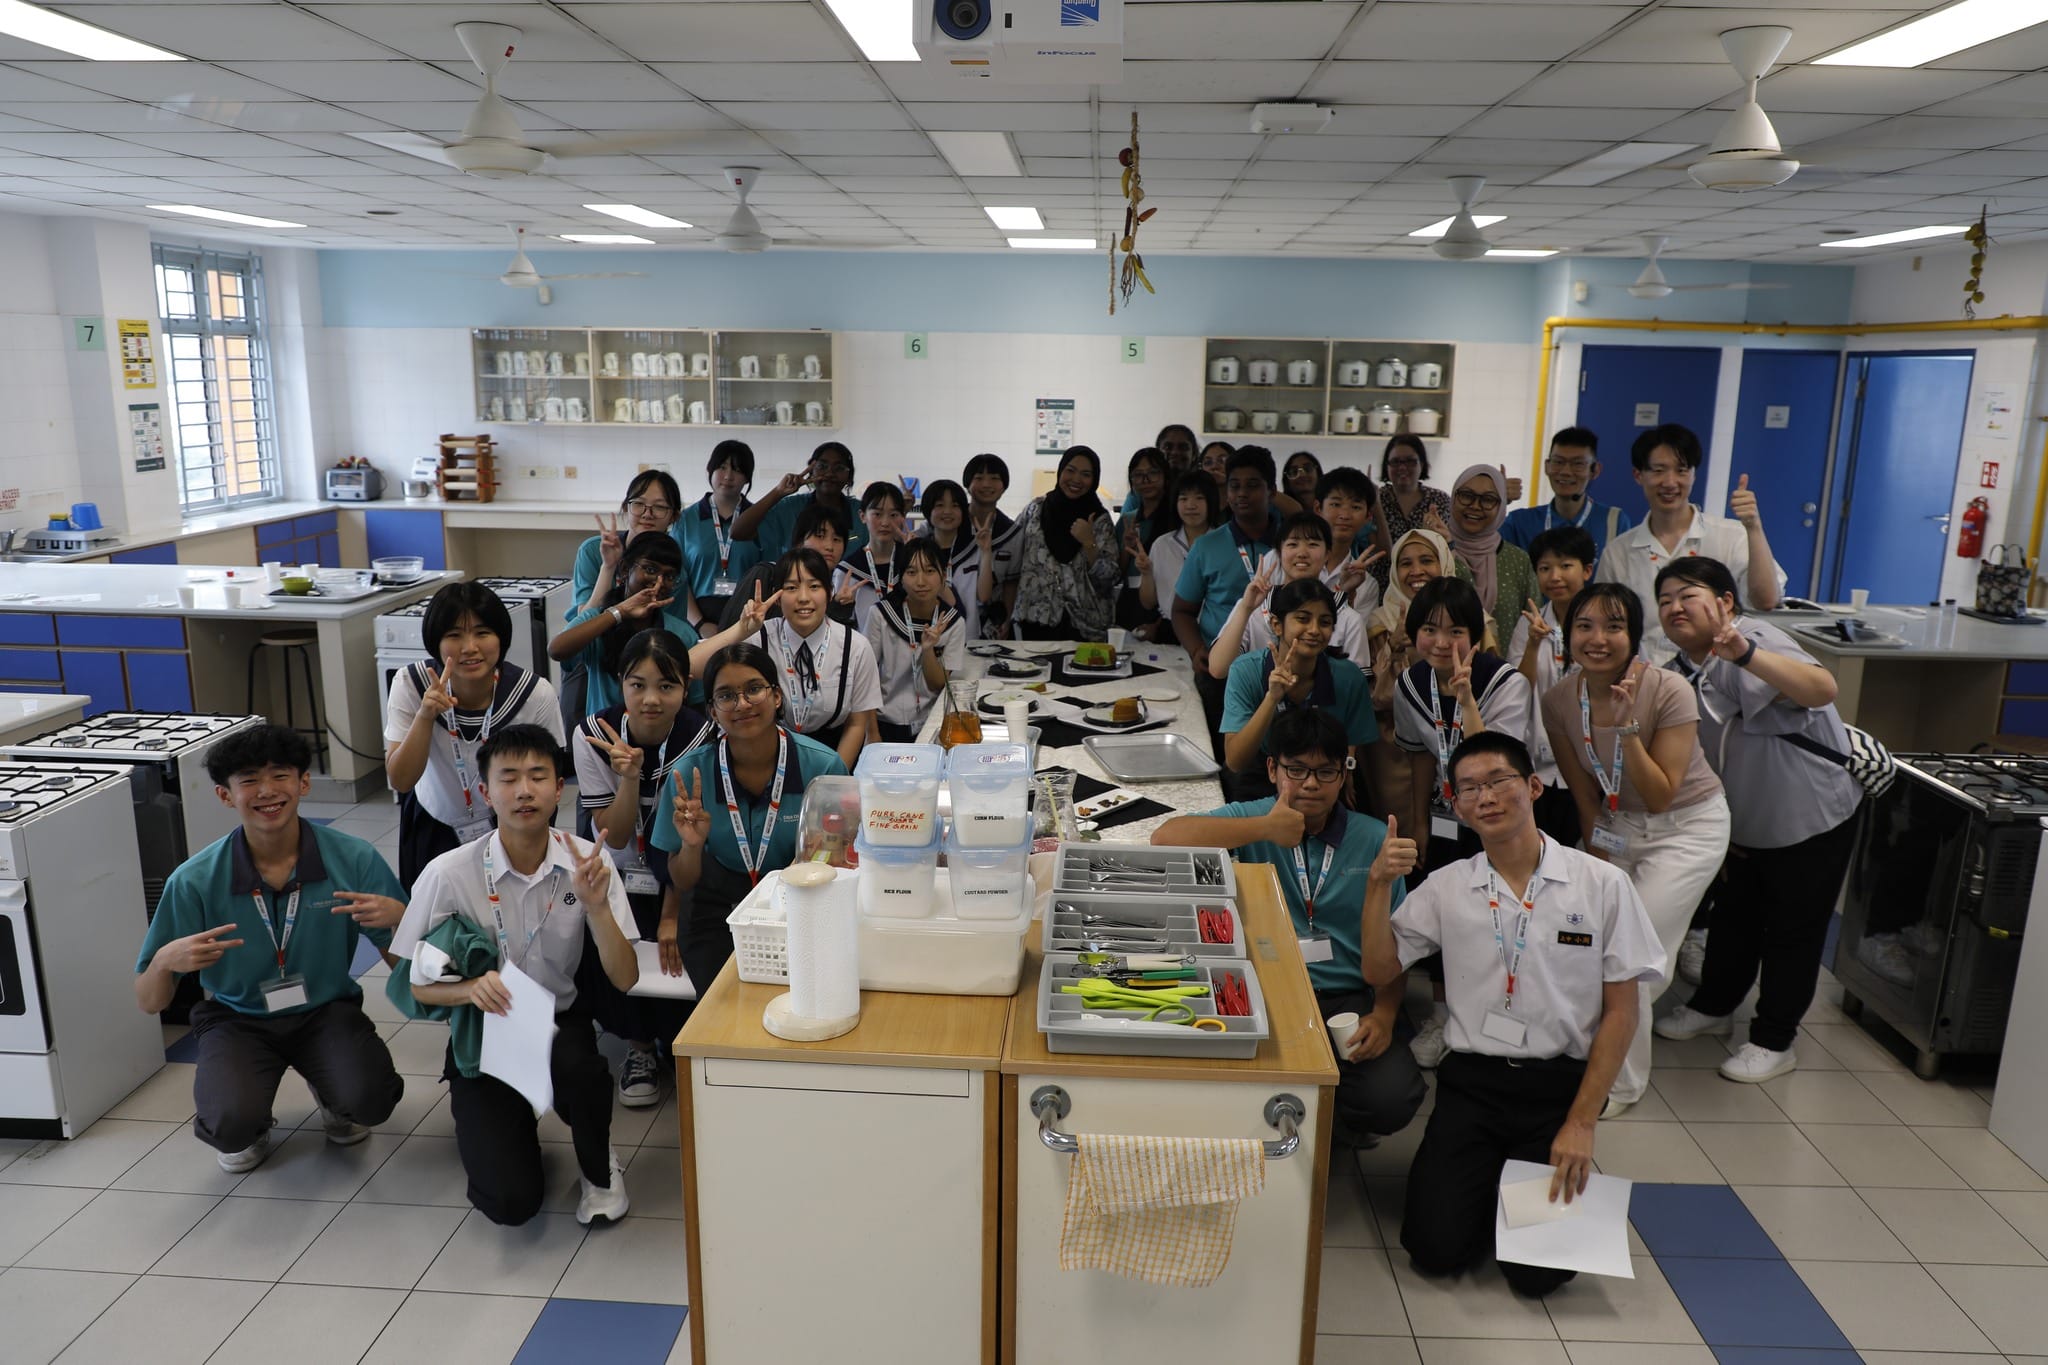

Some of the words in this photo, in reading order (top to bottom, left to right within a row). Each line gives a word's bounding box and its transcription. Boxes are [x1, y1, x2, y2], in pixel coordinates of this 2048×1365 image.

[83, 325, 94, 342] 7
[911, 338, 921, 353] 6
[1128, 342, 1138, 357] 5
[870, 809, 895, 818] PURE
[900, 811, 925, 820] CANE
[869, 821, 890, 829] FINE
